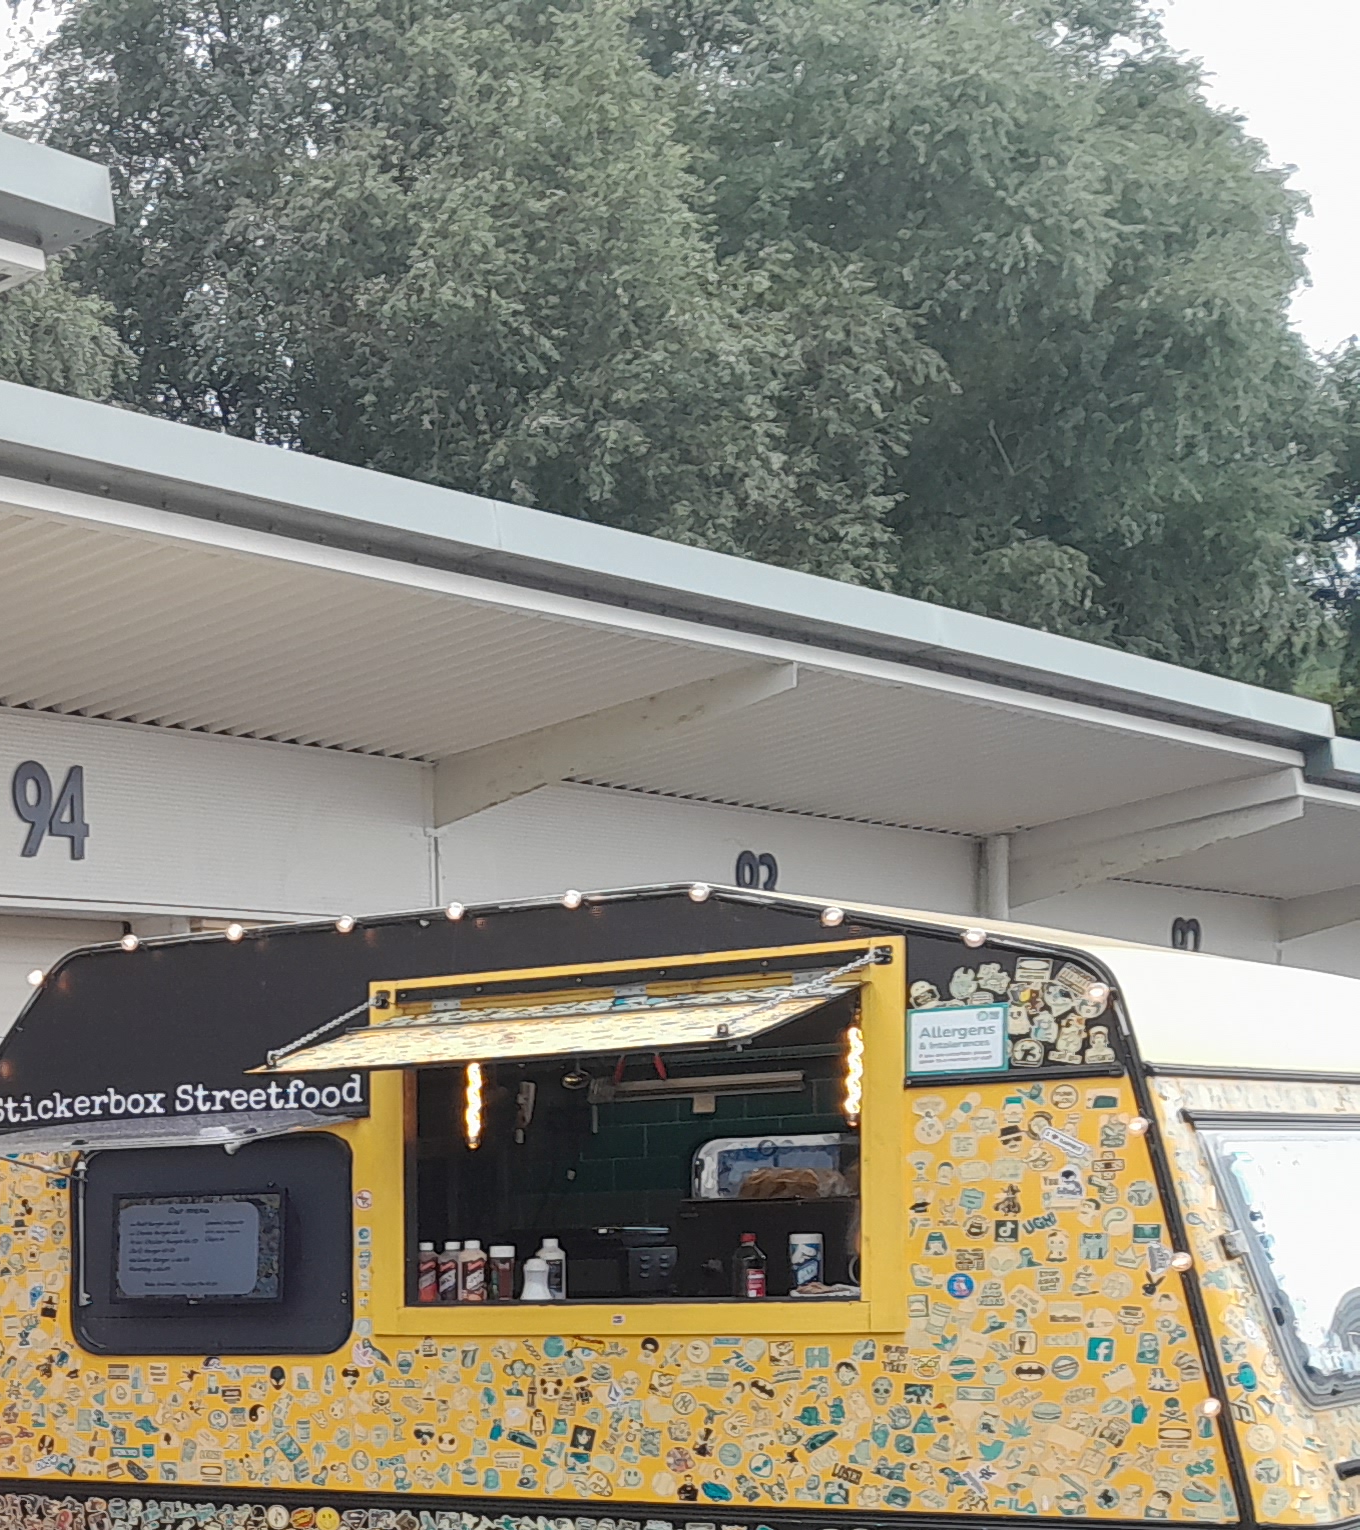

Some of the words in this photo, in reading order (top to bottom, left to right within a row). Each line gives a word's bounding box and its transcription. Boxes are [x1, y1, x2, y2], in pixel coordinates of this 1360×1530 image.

[11, 759, 90, 861] 94
[917, 1025, 997, 1040] Allergens
[174, 1073, 364, 1113] Streetfood
[993, 1496, 1038, 1514] FILA
